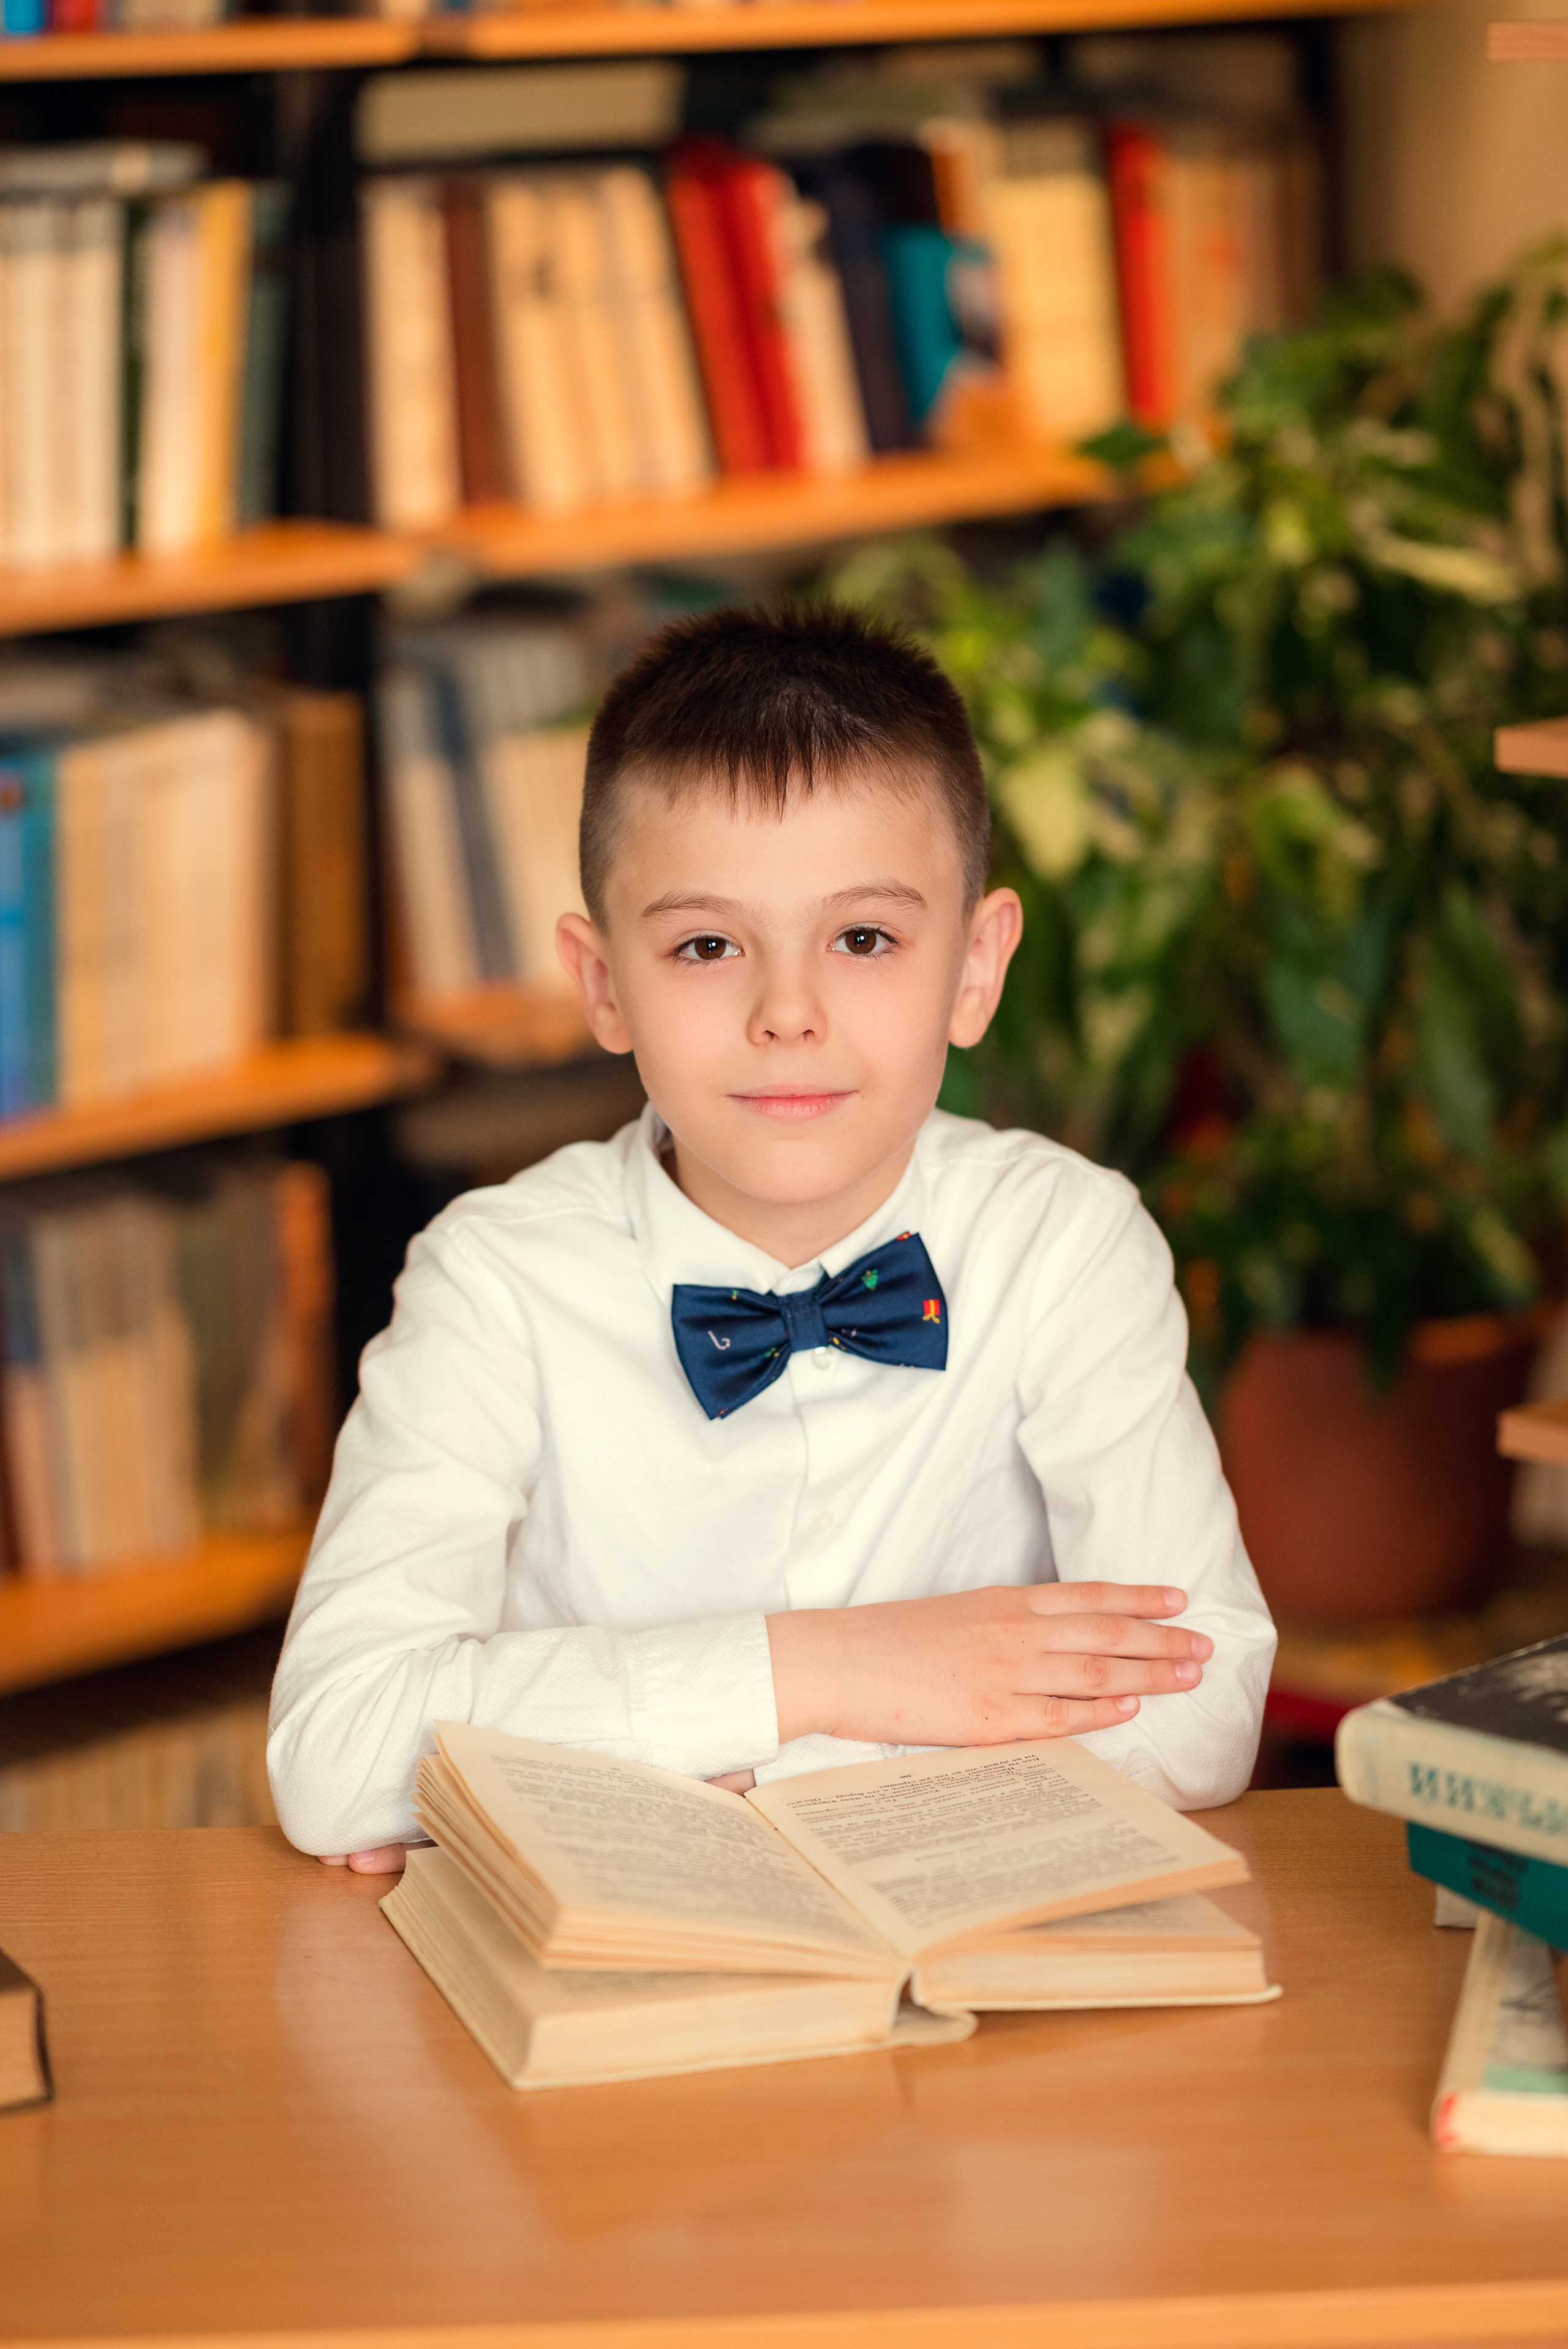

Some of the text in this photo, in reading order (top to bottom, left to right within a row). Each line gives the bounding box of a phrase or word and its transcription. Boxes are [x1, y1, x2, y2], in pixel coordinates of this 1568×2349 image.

[979, 1760, 1009, 1769] думай,
[967, 1765, 1005, 1776] живешь?
[983, 1766, 1015, 1775] Ничего
[876, 1780, 916, 1788] страшно.
[1023, 1773, 1061, 1786] устроил?
[891, 1780, 933, 1790] потерлась
[873, 1788, 927, 1801] спрашиваю?
[901, 1788, 941, 1799] Танюша.
[788, 1799, 837, 1809] изменился.
[795, 1807, 840, 1816] торопился
